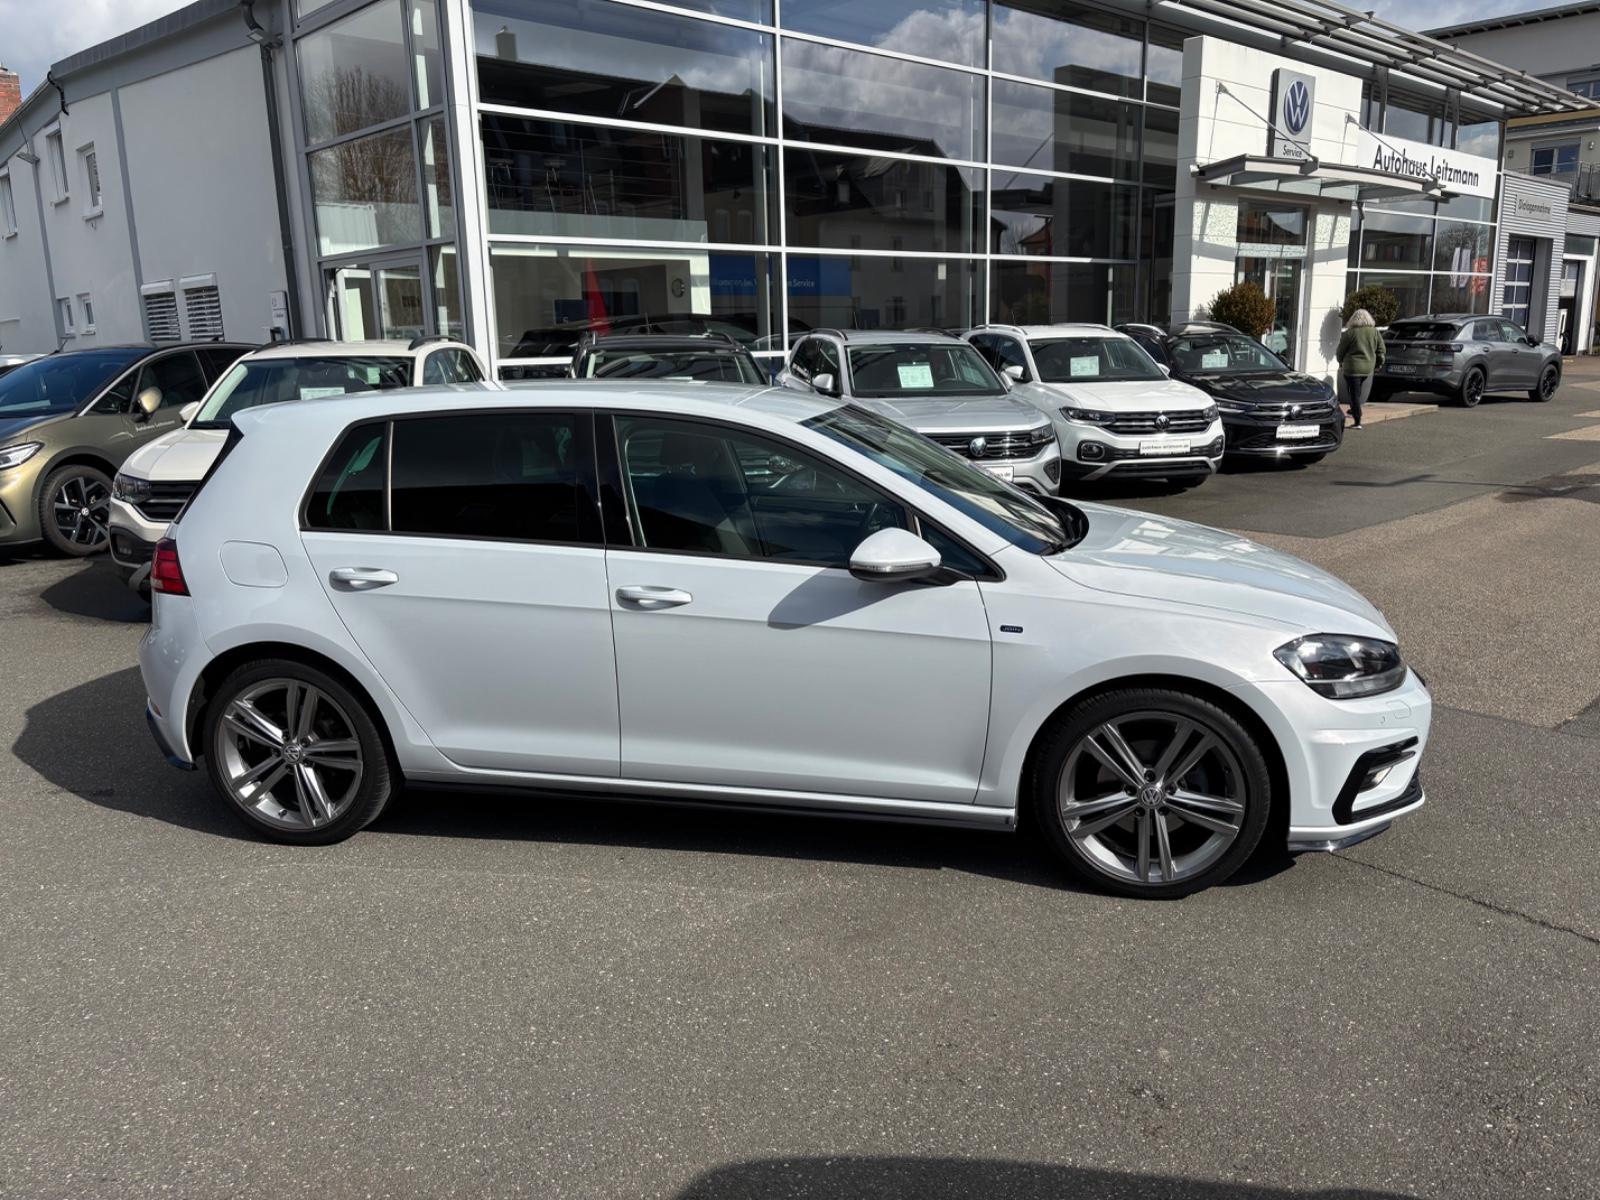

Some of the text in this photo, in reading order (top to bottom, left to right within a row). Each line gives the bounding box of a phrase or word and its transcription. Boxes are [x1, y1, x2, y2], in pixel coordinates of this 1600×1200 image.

[1282, 144, 1303, 157] Service
[1373, 144, 1479, 187] Autohaus Leitzmann
